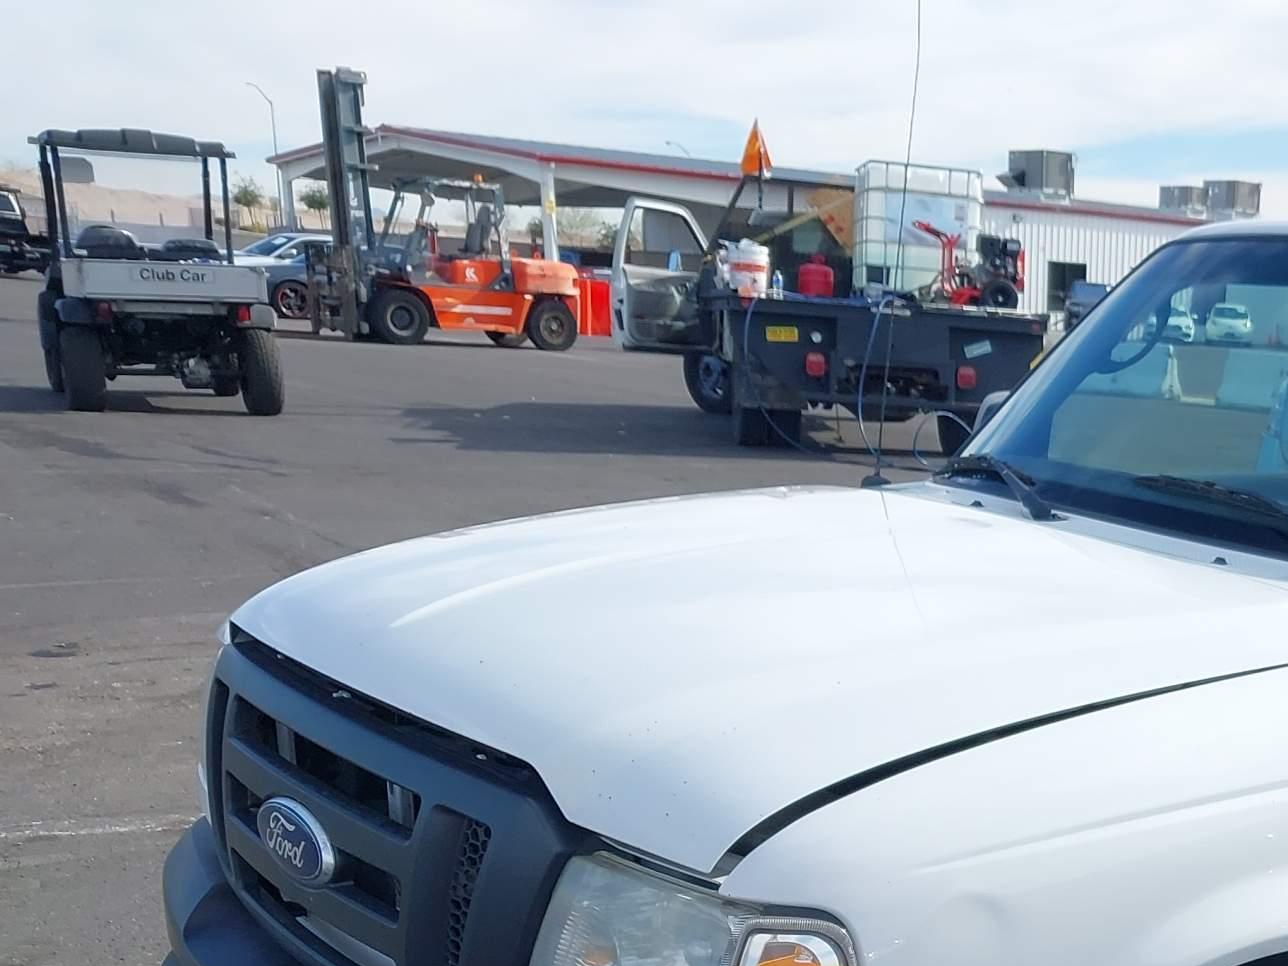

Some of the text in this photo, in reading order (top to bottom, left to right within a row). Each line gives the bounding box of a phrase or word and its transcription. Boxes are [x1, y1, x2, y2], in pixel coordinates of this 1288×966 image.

[140, 267, 207, 282] Club Car
[266, 812, 305, 868] Ford
